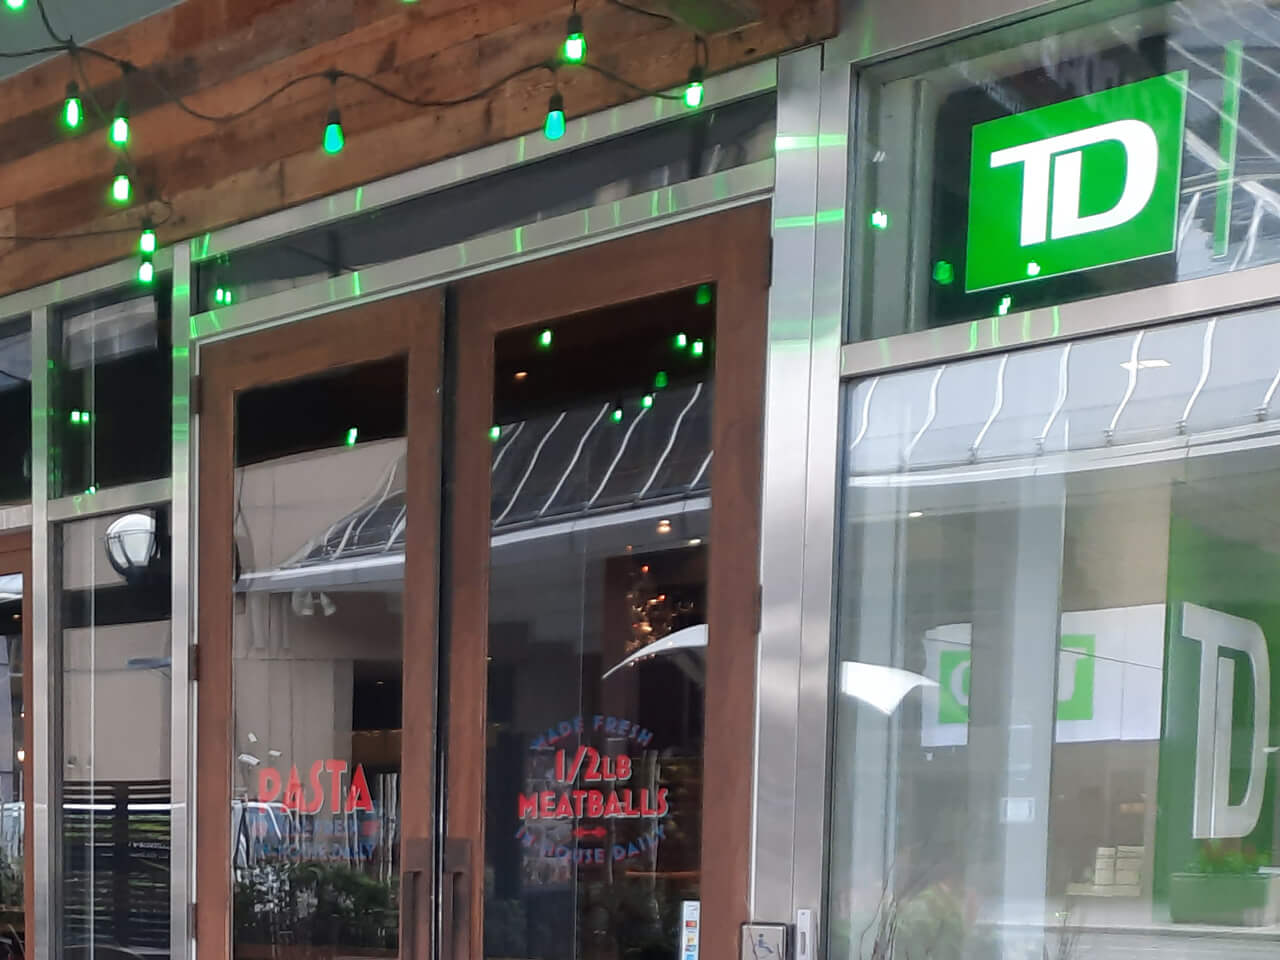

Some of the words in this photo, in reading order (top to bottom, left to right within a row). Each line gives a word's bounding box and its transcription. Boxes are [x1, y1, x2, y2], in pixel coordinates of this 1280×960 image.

[989, 118, 1160, 247] TD
[593, 714, 654, 747] FRESH
[1181, 601, 1270, 839] TD
[257, 758, 375, 815] PASTA
[517, 787, 669, 820] MEATBALLS
